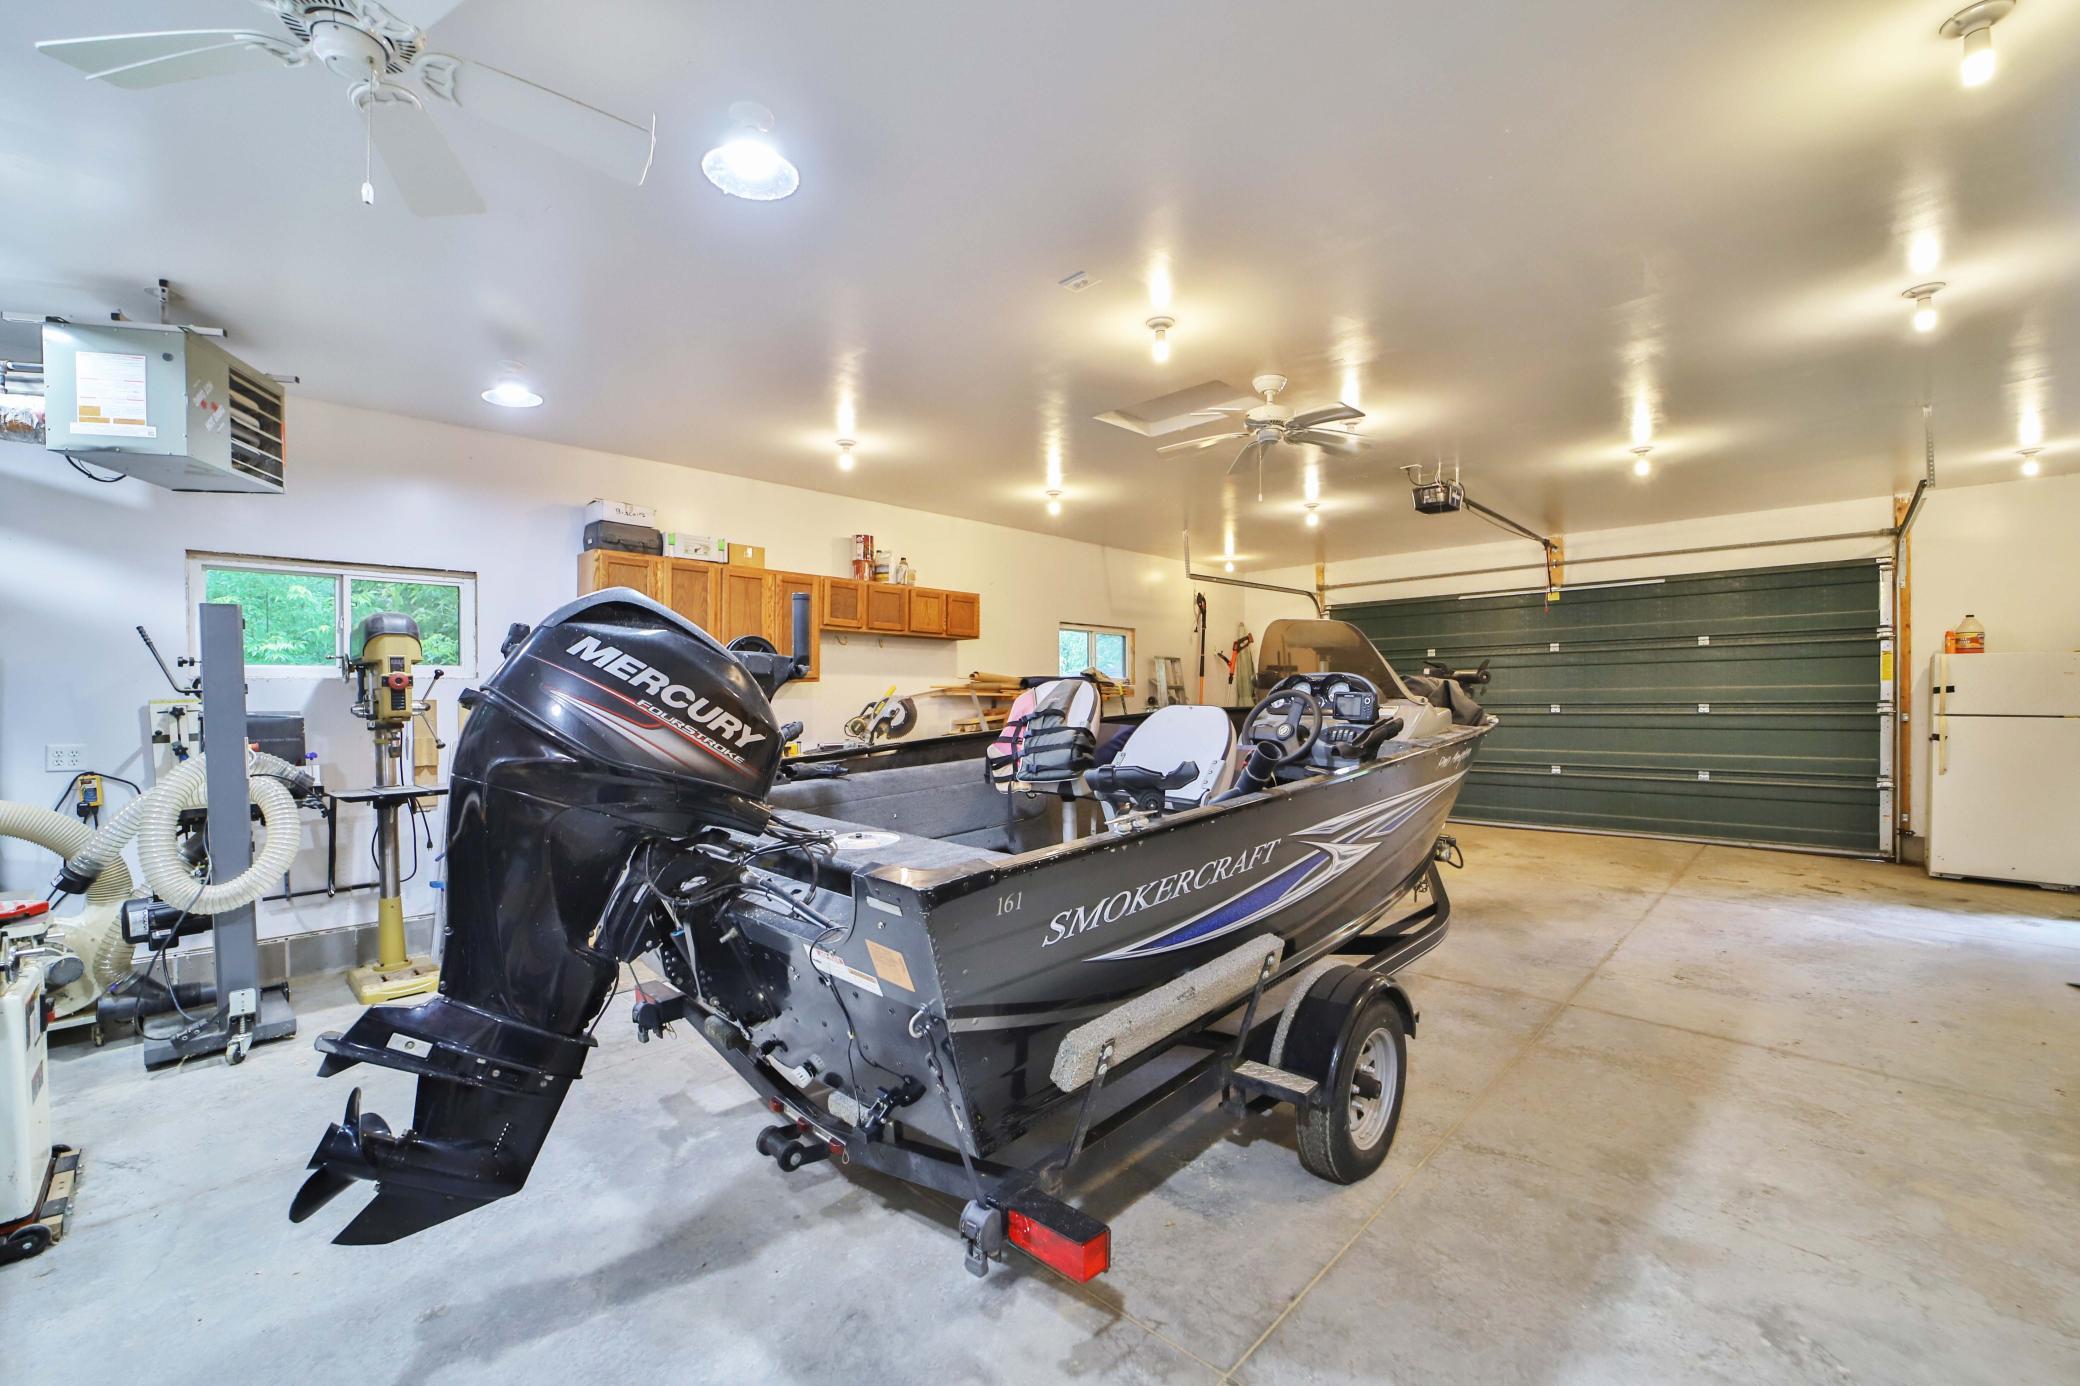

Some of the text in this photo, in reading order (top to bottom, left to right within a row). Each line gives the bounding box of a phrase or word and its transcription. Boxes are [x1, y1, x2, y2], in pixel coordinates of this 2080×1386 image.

[566, 636, 765, 748] MERCURY
[635, 699, 746, 764] FOURSTROKE
[996, 892, 1022, 916] 161
[1041, 839, 1281, 947] SMOKERCRAFT
